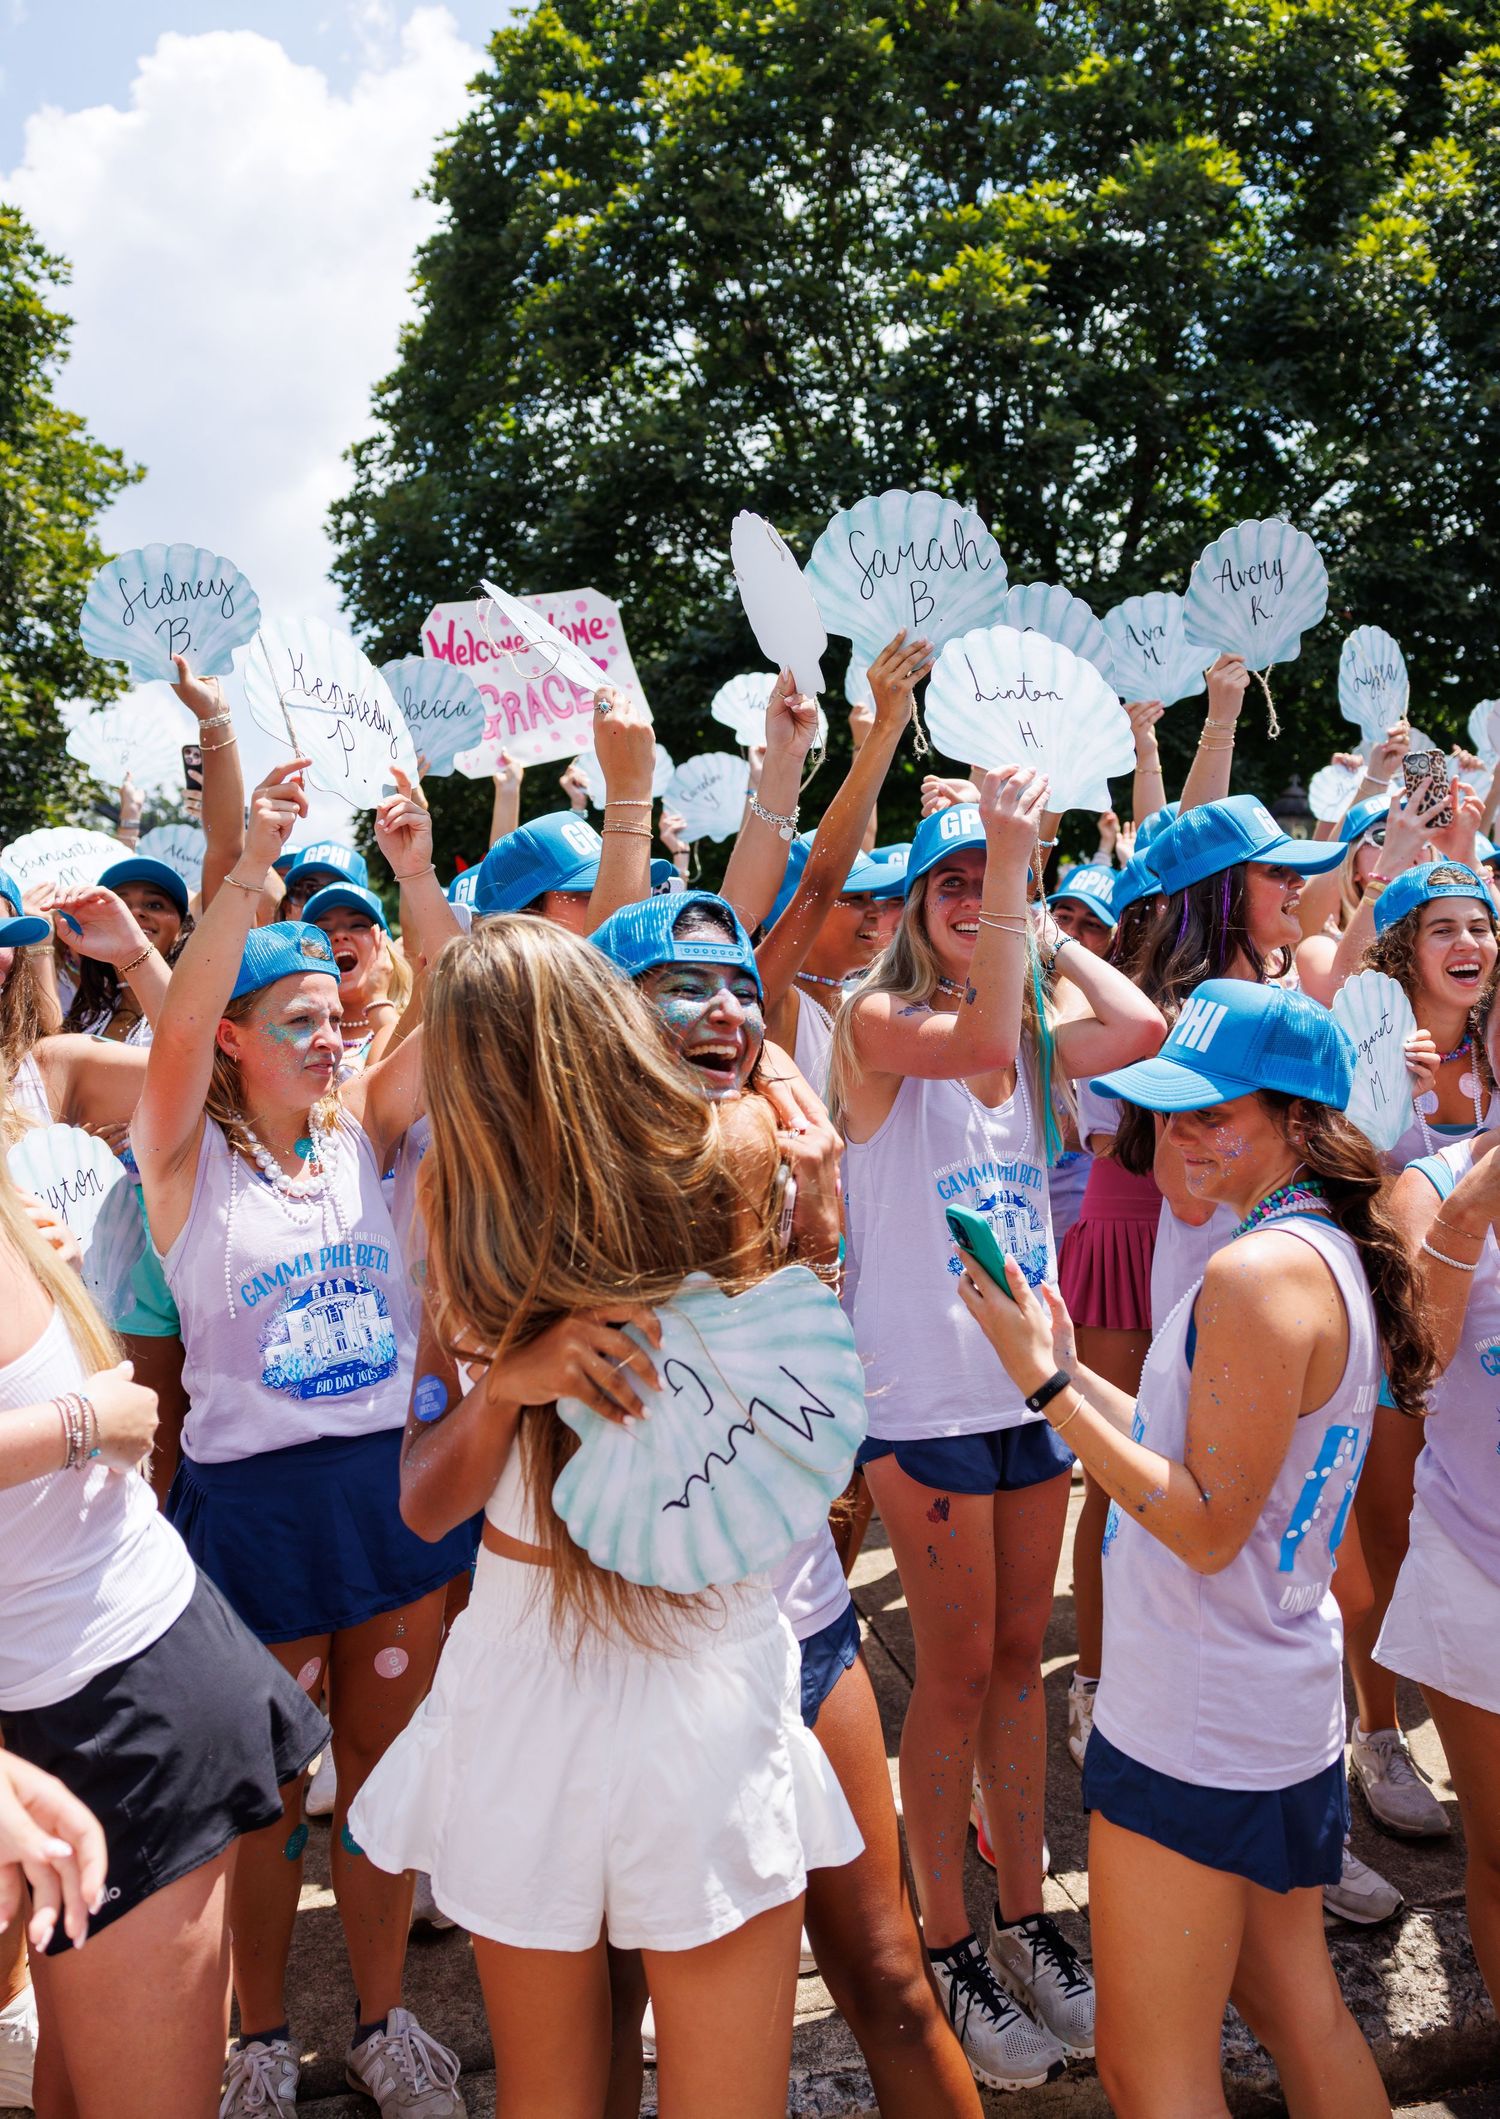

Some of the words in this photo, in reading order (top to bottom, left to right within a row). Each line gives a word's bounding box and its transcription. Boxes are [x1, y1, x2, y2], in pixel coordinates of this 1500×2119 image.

[849, 519, 992, 600] Sarah
[1212, 558, 1288, 595] Avery
[119, 573, 234, 626] Sidney
[910, 580, 943, 627] B.
[1251, 595, 1273, 626] K.
[426, 620, 529, 666] Welcome
[548, 613, 609, 645] ome
[1122, 623, 1166, 647] Ava
[964, 653, 1064, 702] Linton
[288, 648, 398, 759] Kennedy
[403, 686, 471, 720] becca
[478, 676, 595, 740] GRACE
[1019, 720, 1044, 748] H.
[303, 844, 351, 870] GPHI
[1166, 997, 1228, 1053] PHI
[1357, 1008, 1393, 1064] rgaret
[1019, 1163, 1043, 1192] BETA
[240, 1251, 315, 1308] GAMMA
[319, 1243, 351, 1272] PHI
[356, 1243, 390, 1274] BETA
[316, 1380, 333, 1394] BID
[336, 1373, 355, 1390] DAY
[357, 1367, 379, 1384] 2025
